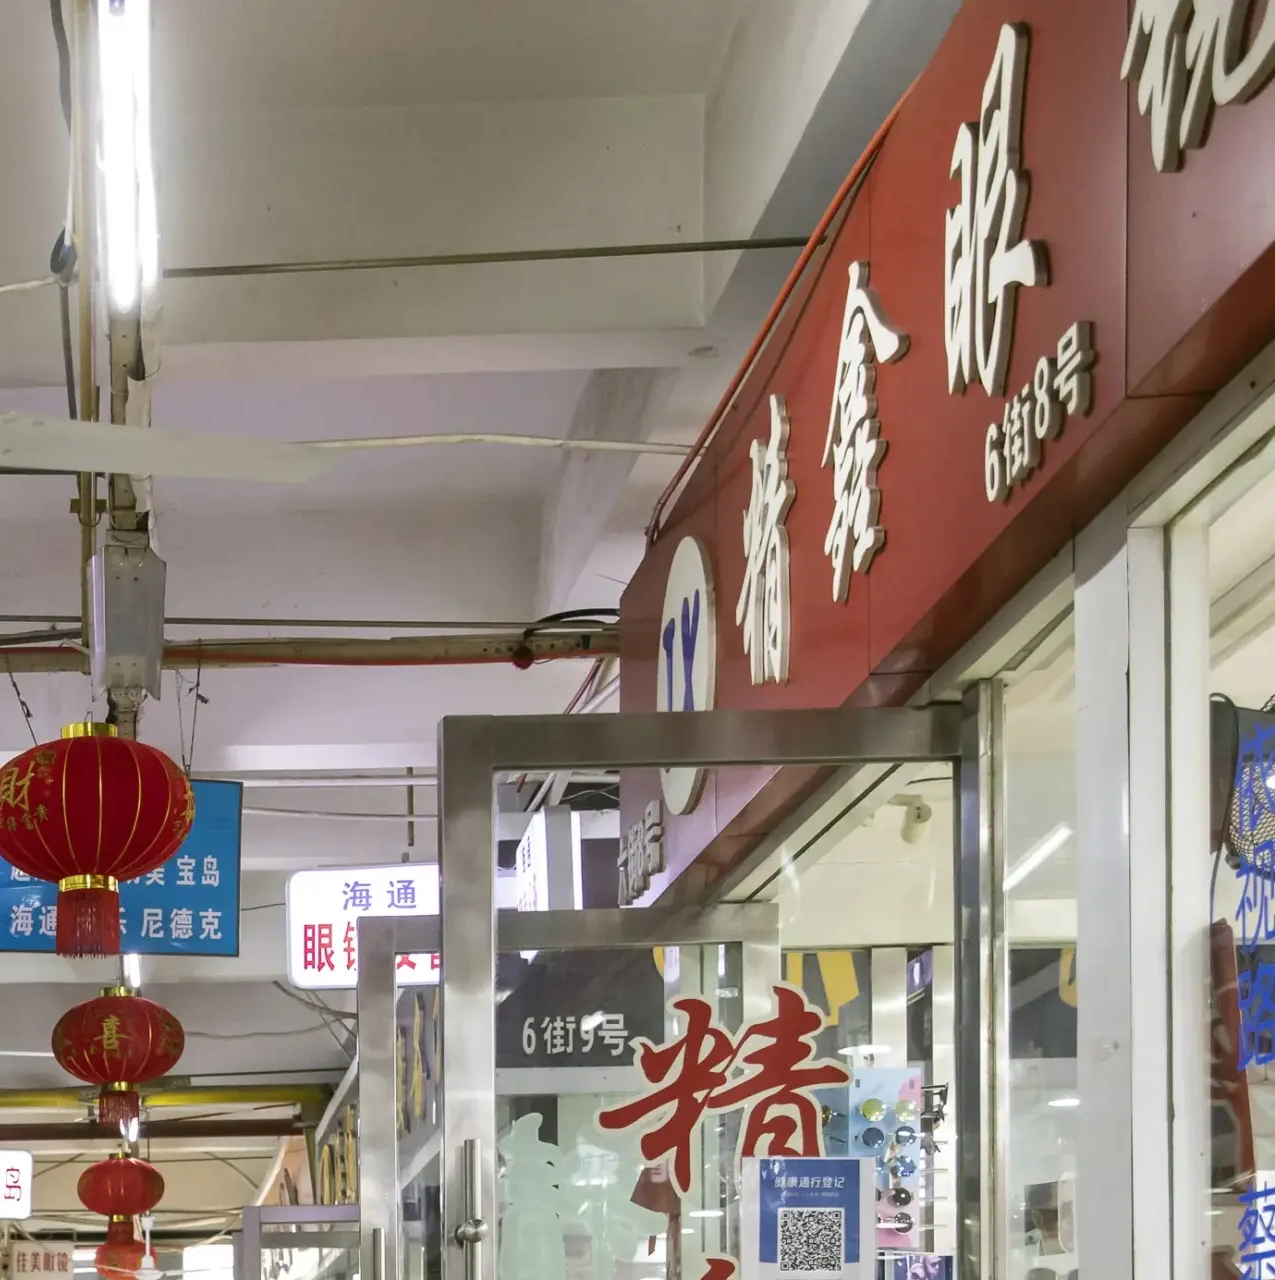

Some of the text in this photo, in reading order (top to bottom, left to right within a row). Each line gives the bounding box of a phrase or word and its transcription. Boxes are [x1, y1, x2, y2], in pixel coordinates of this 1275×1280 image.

[984, 320, 1097, 503] 6街8号
[176, 854, 221, 887] 宝岛
[341, 879, 418, 911] 海通
[10, 905, 223, 941] 海通 尼德克
[521, 1013, 629, 1057] 6街9号
[774, 1176, 847, 1189] 健康通行登记
